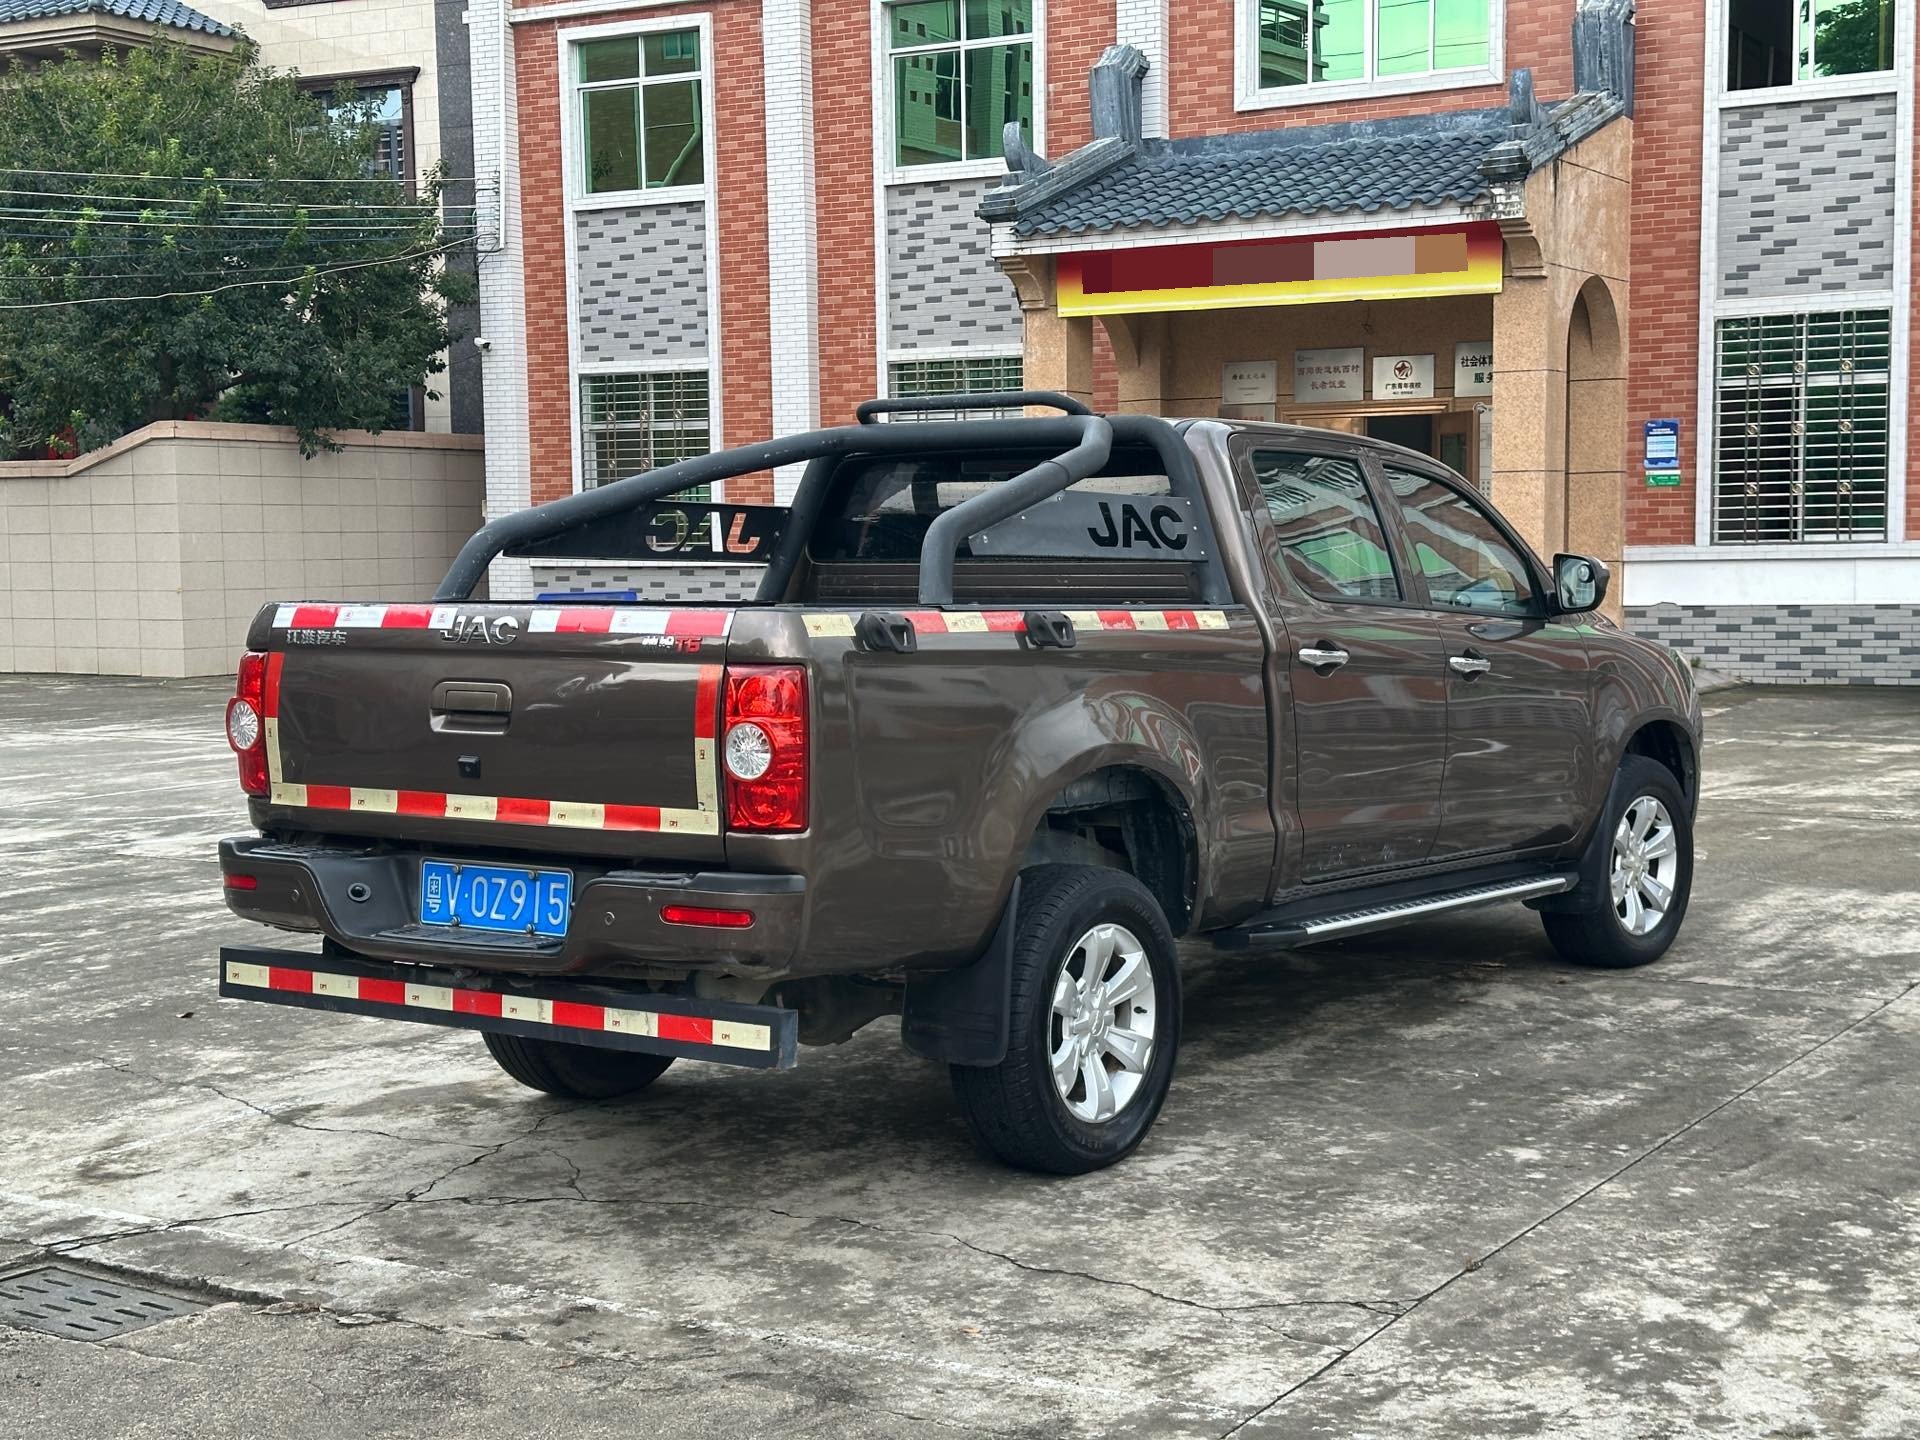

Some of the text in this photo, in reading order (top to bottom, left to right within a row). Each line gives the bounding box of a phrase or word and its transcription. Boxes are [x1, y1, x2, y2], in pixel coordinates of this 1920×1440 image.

[1087, 502, 1188, 551] JAC
[286, 628, 348, 646] 江淮汽车
[440, 615, 519, 645] JAC
